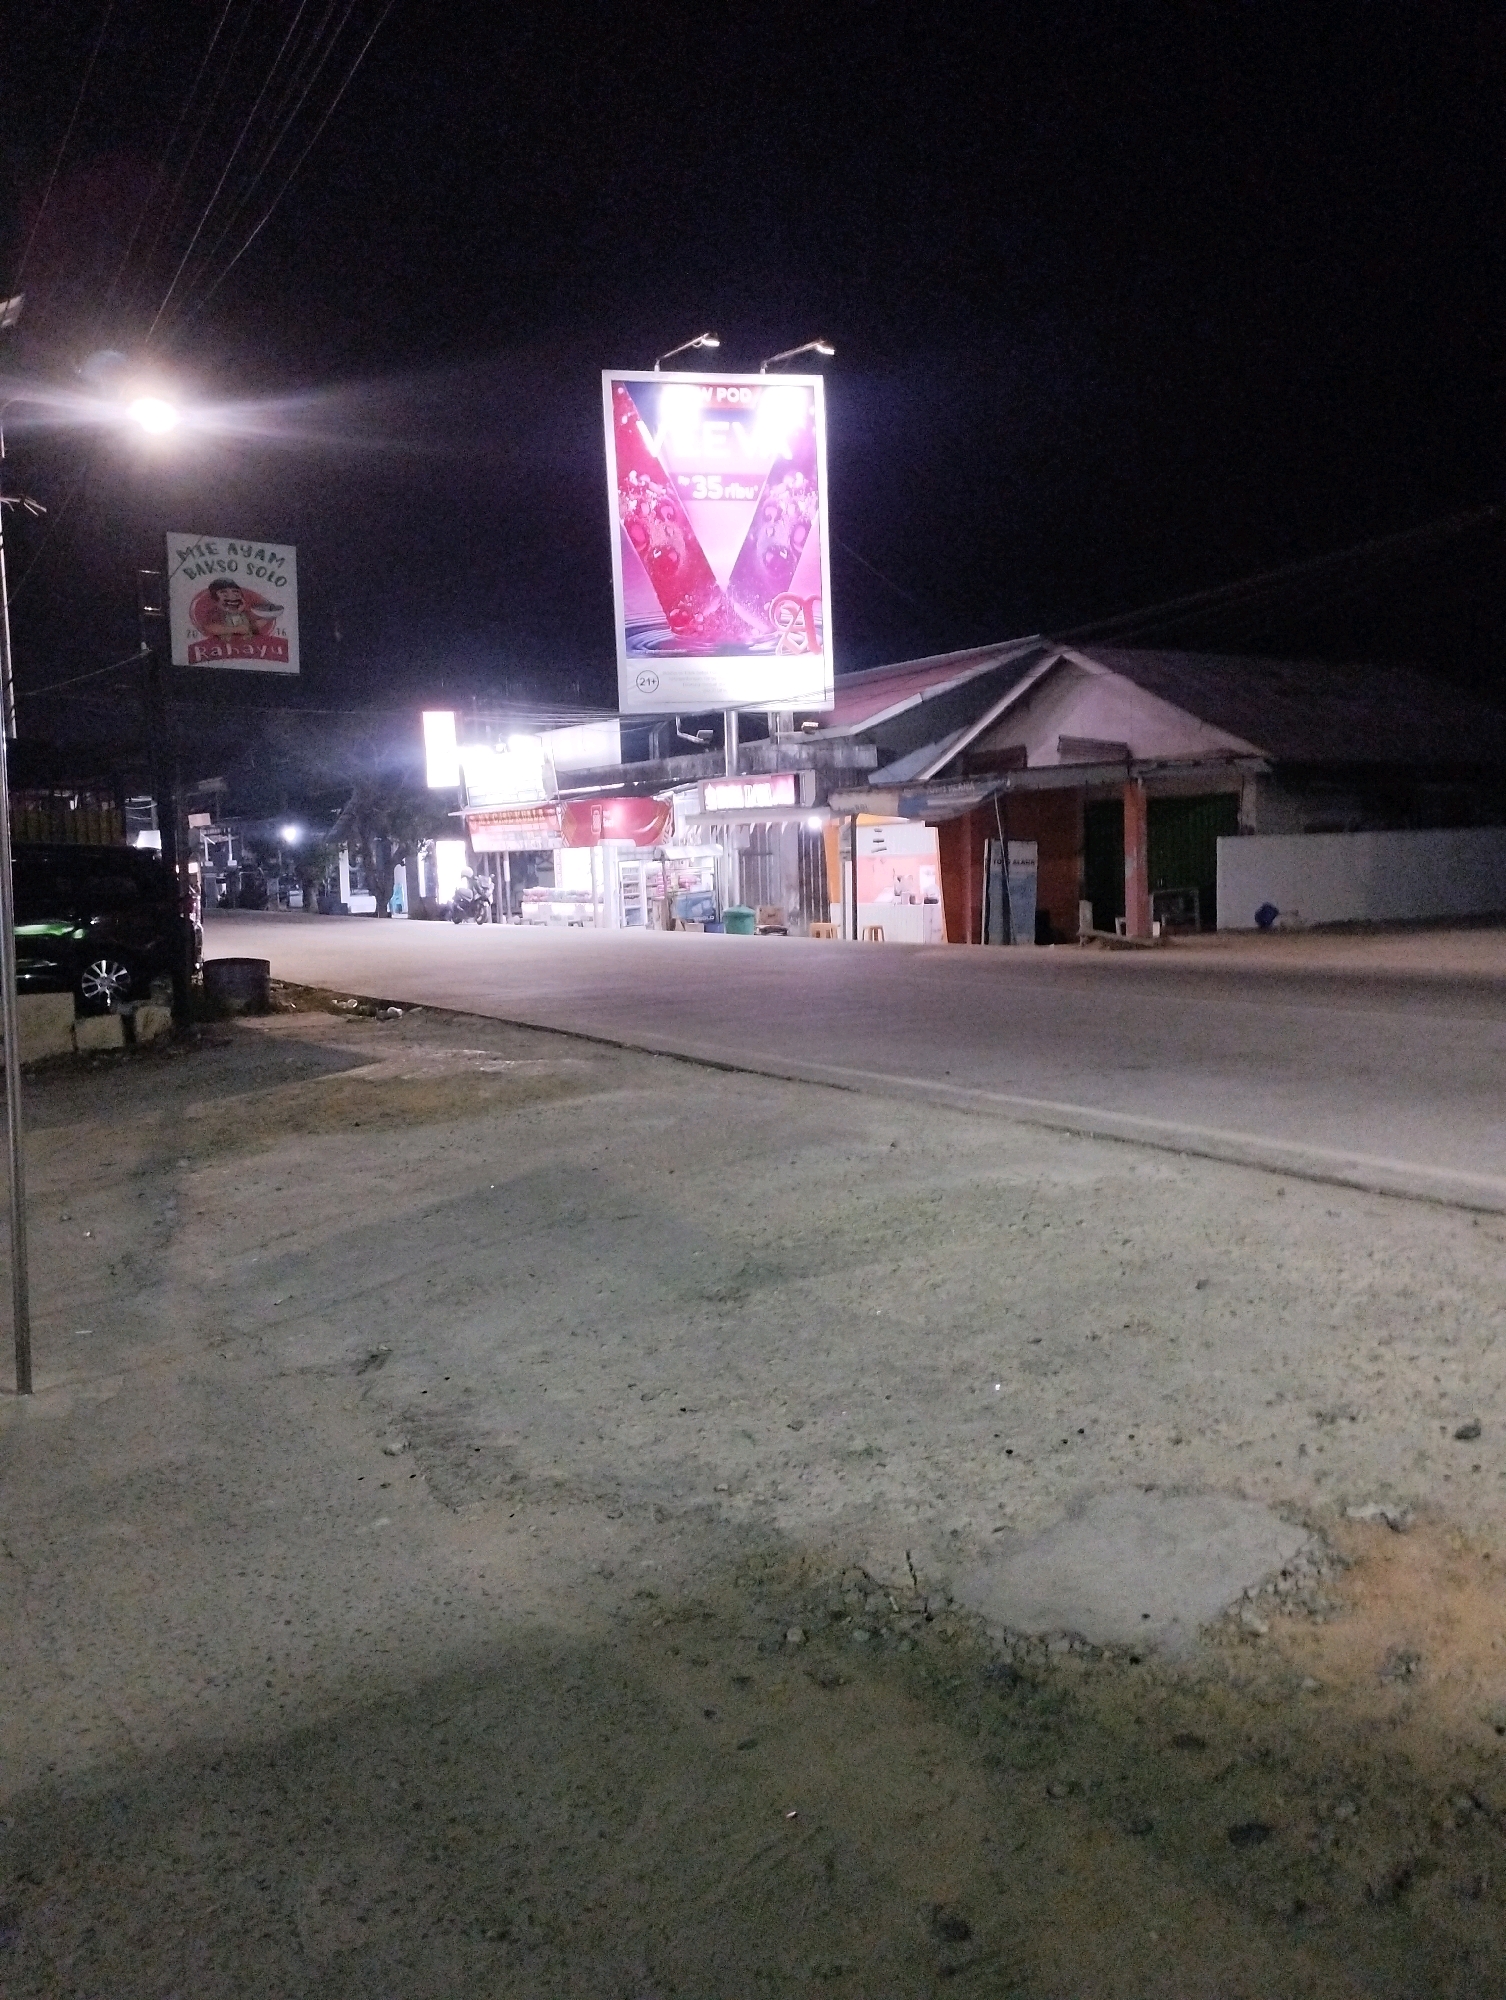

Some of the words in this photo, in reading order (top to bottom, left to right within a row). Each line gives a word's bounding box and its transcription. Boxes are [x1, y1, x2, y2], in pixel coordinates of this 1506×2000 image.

[717, 387, 752, 403] POD
[691, 474, 724, 500] 35
[176, 542, 220, 561] MIE
[227, 542, 286, 569] AYAM
[183, 558, 239, 581] BAKSO
[246, 562, 288, 587] SOLO
[194, 643, 283, 662] Rahayu
[639, 677, 658, 687] 21+
